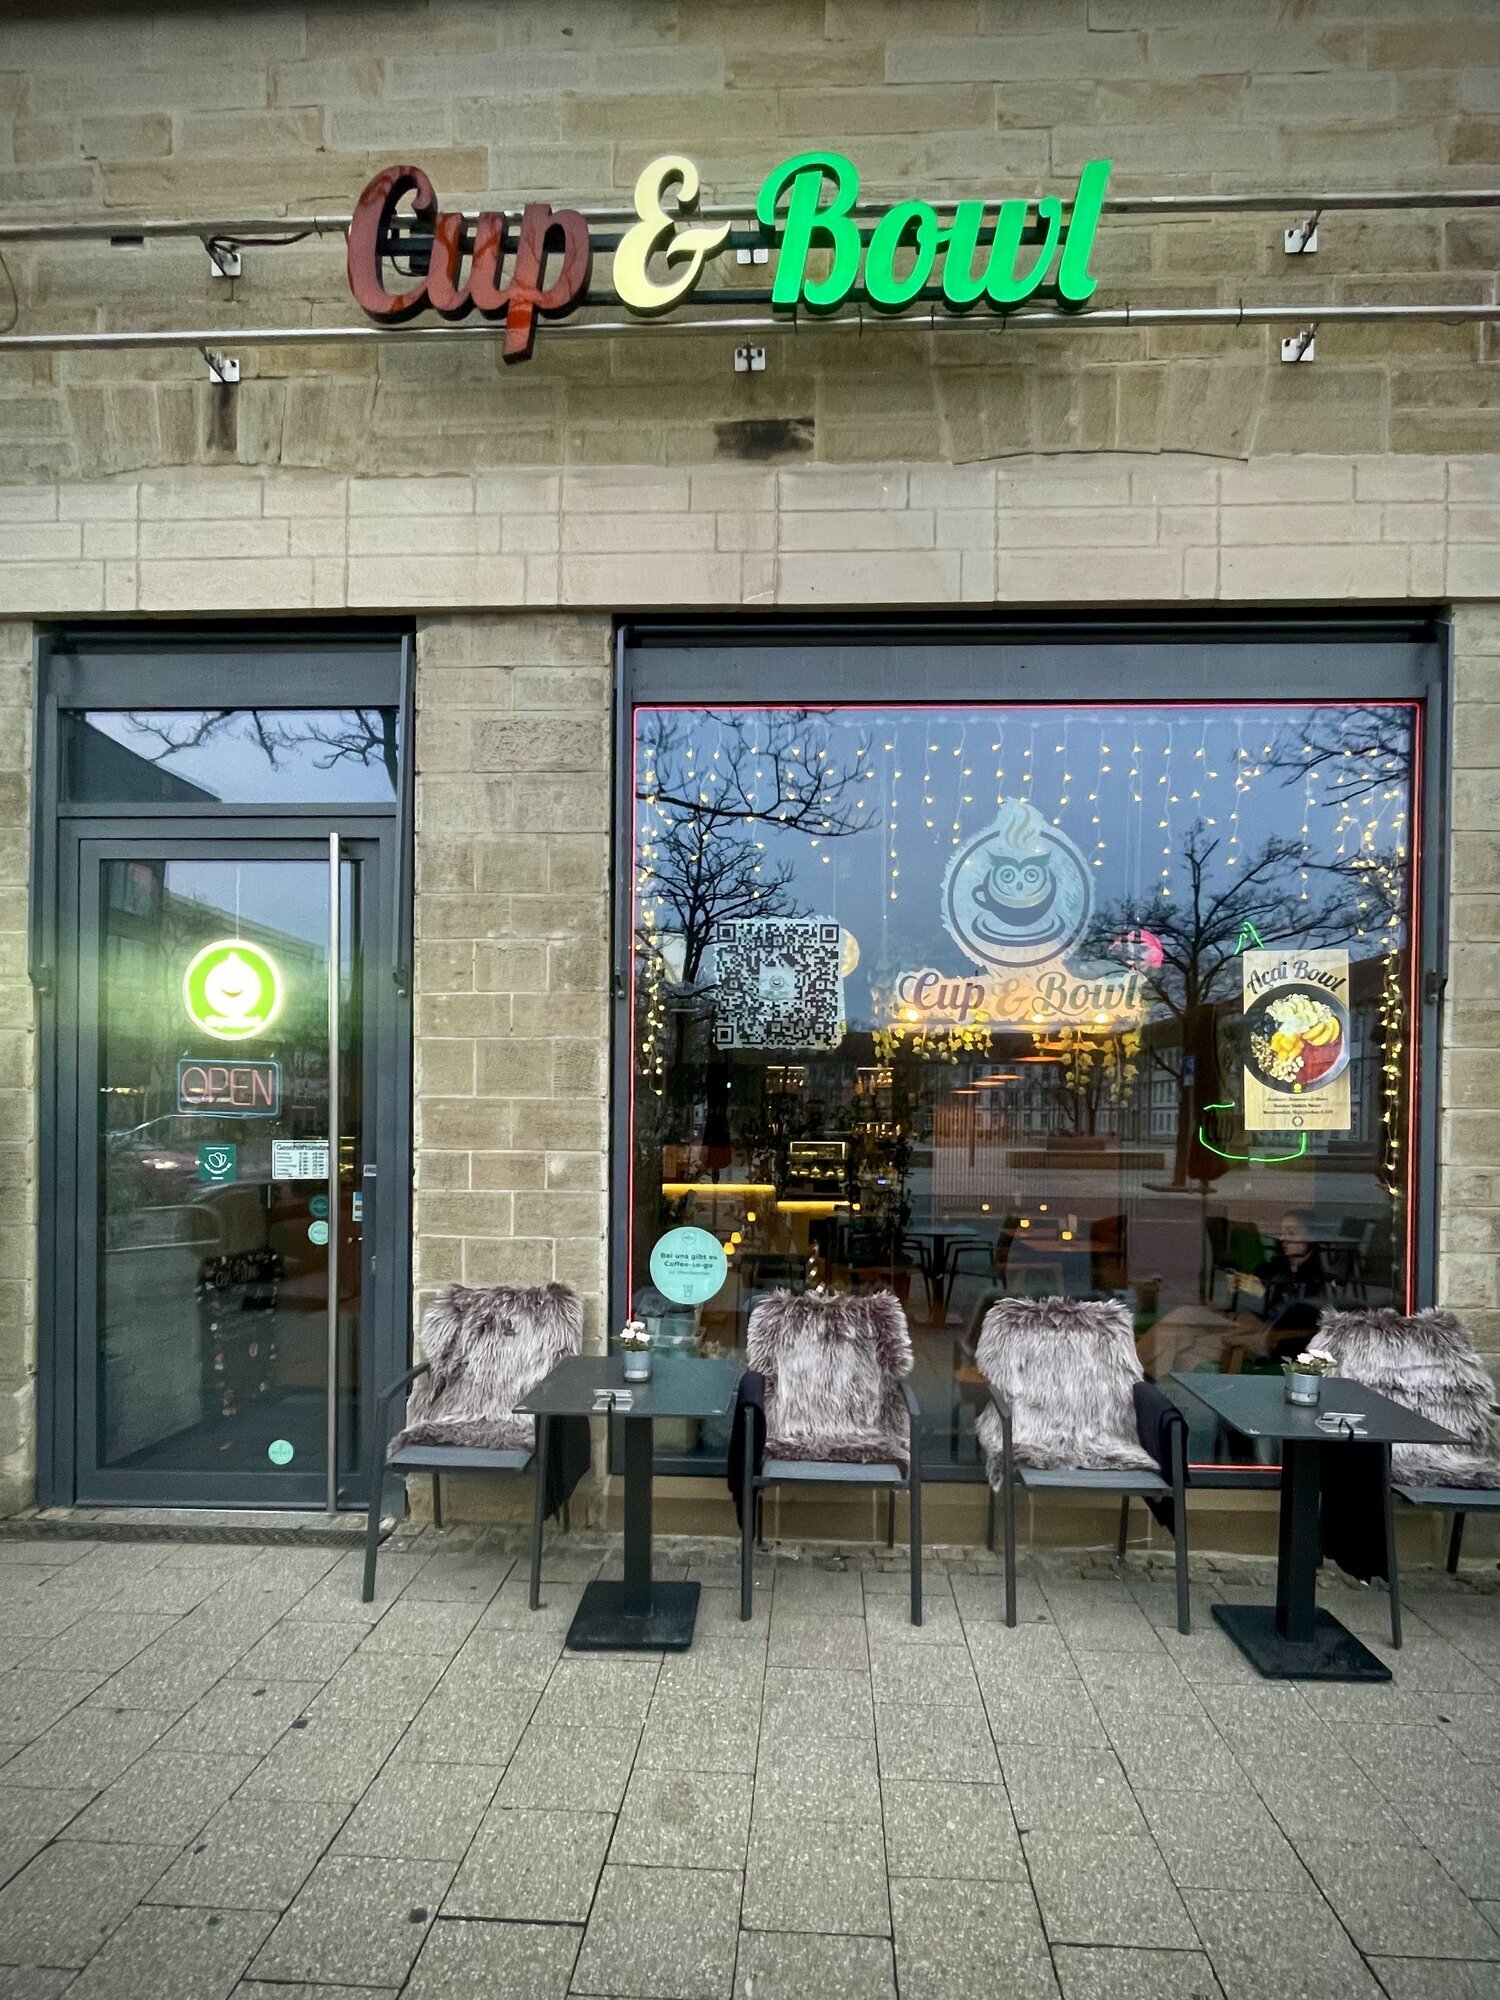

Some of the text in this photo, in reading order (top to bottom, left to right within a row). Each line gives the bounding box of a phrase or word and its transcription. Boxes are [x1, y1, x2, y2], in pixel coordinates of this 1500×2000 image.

[347, 152, 1113, 363] Cup & Bowl
[899, 971, 1138, 1021] Cup & Bowl
[1247, 960, 1347, 995] Açai Bowl
[181, 1066, 273, 1106] OPEN
[664, 1260, 713, 1270] Coffee-to-go
